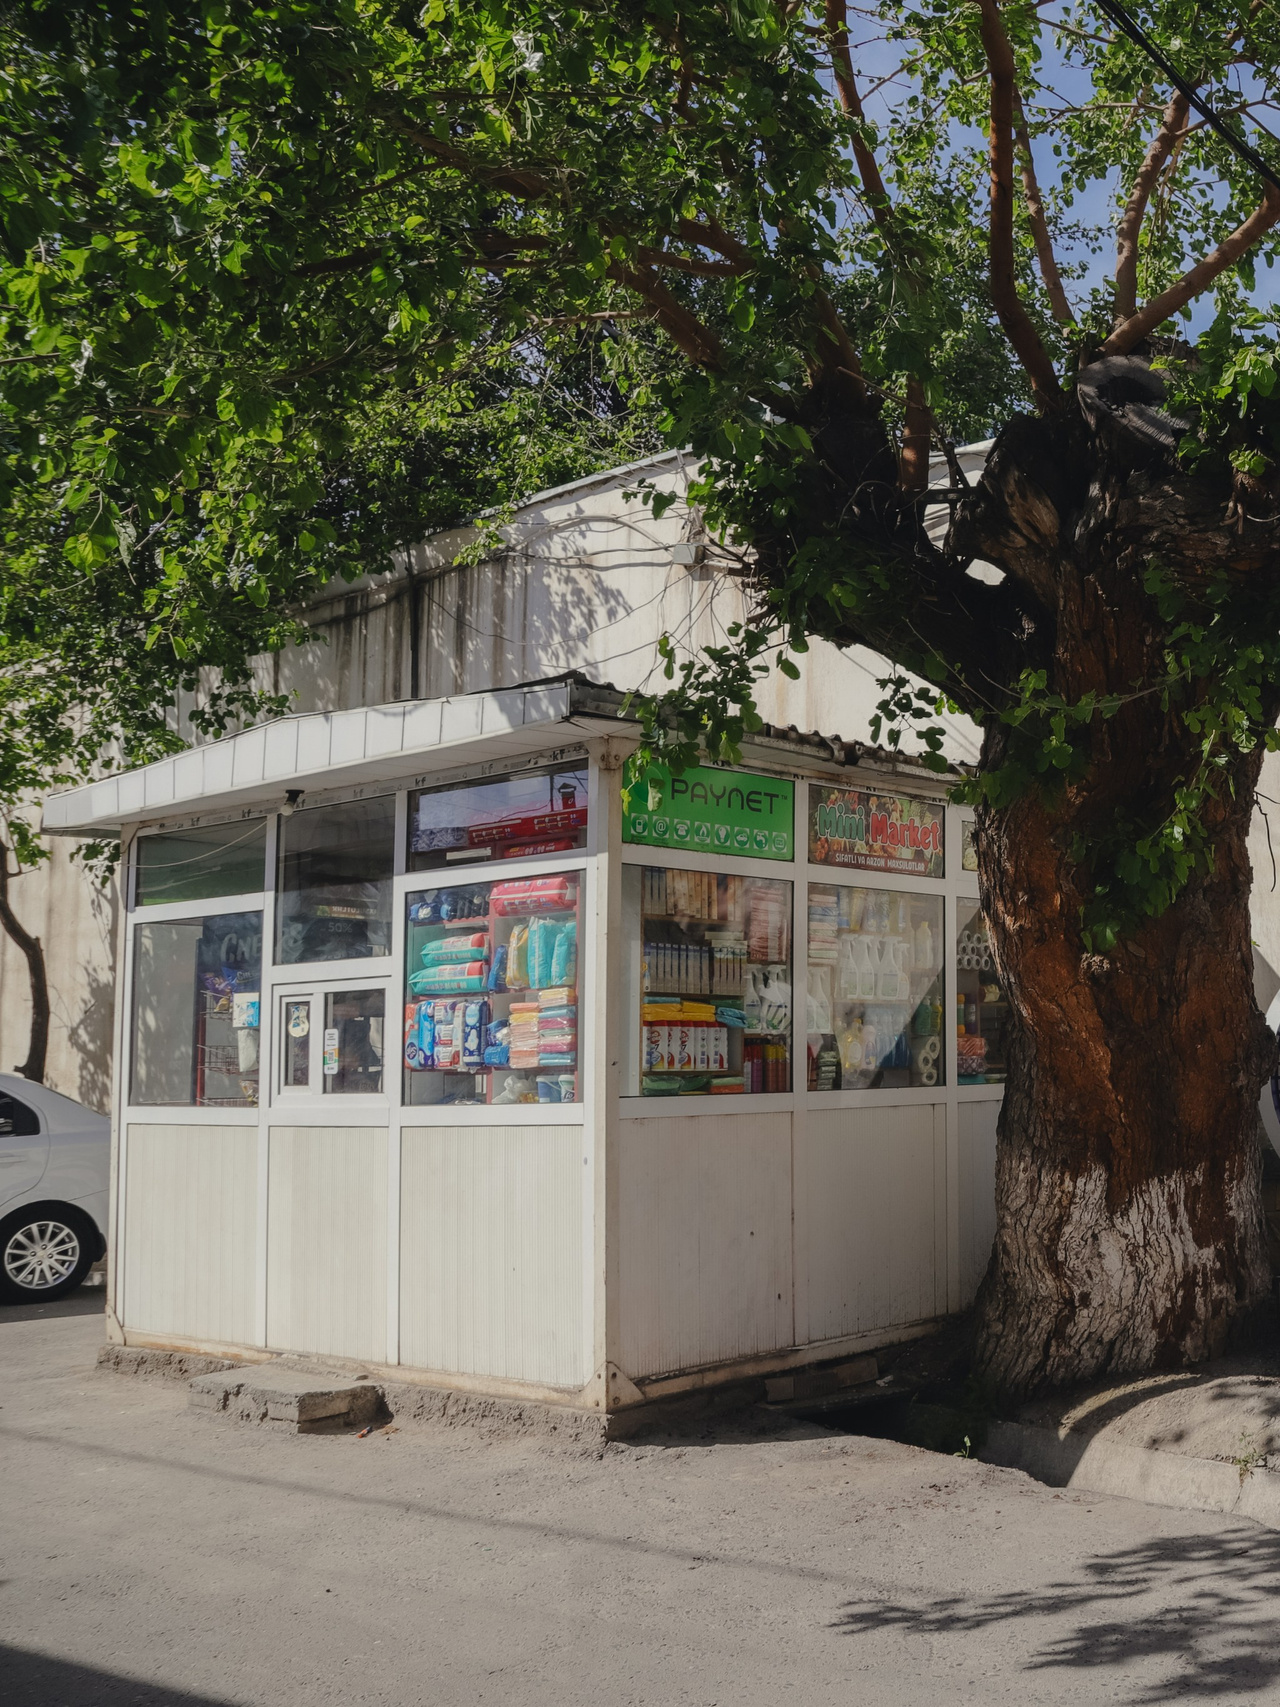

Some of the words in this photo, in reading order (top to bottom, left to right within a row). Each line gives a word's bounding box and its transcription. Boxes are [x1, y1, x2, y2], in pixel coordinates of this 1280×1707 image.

[671, 778, 779, 814] PAYNET
[817, 803, 865, 841] Mini
[870, 812, 940, 852] Market
[835, 853, 857, 864] SIFATLI
[857, 856, 866, 865] VA
[866, 857, 886, 868] ARZON
